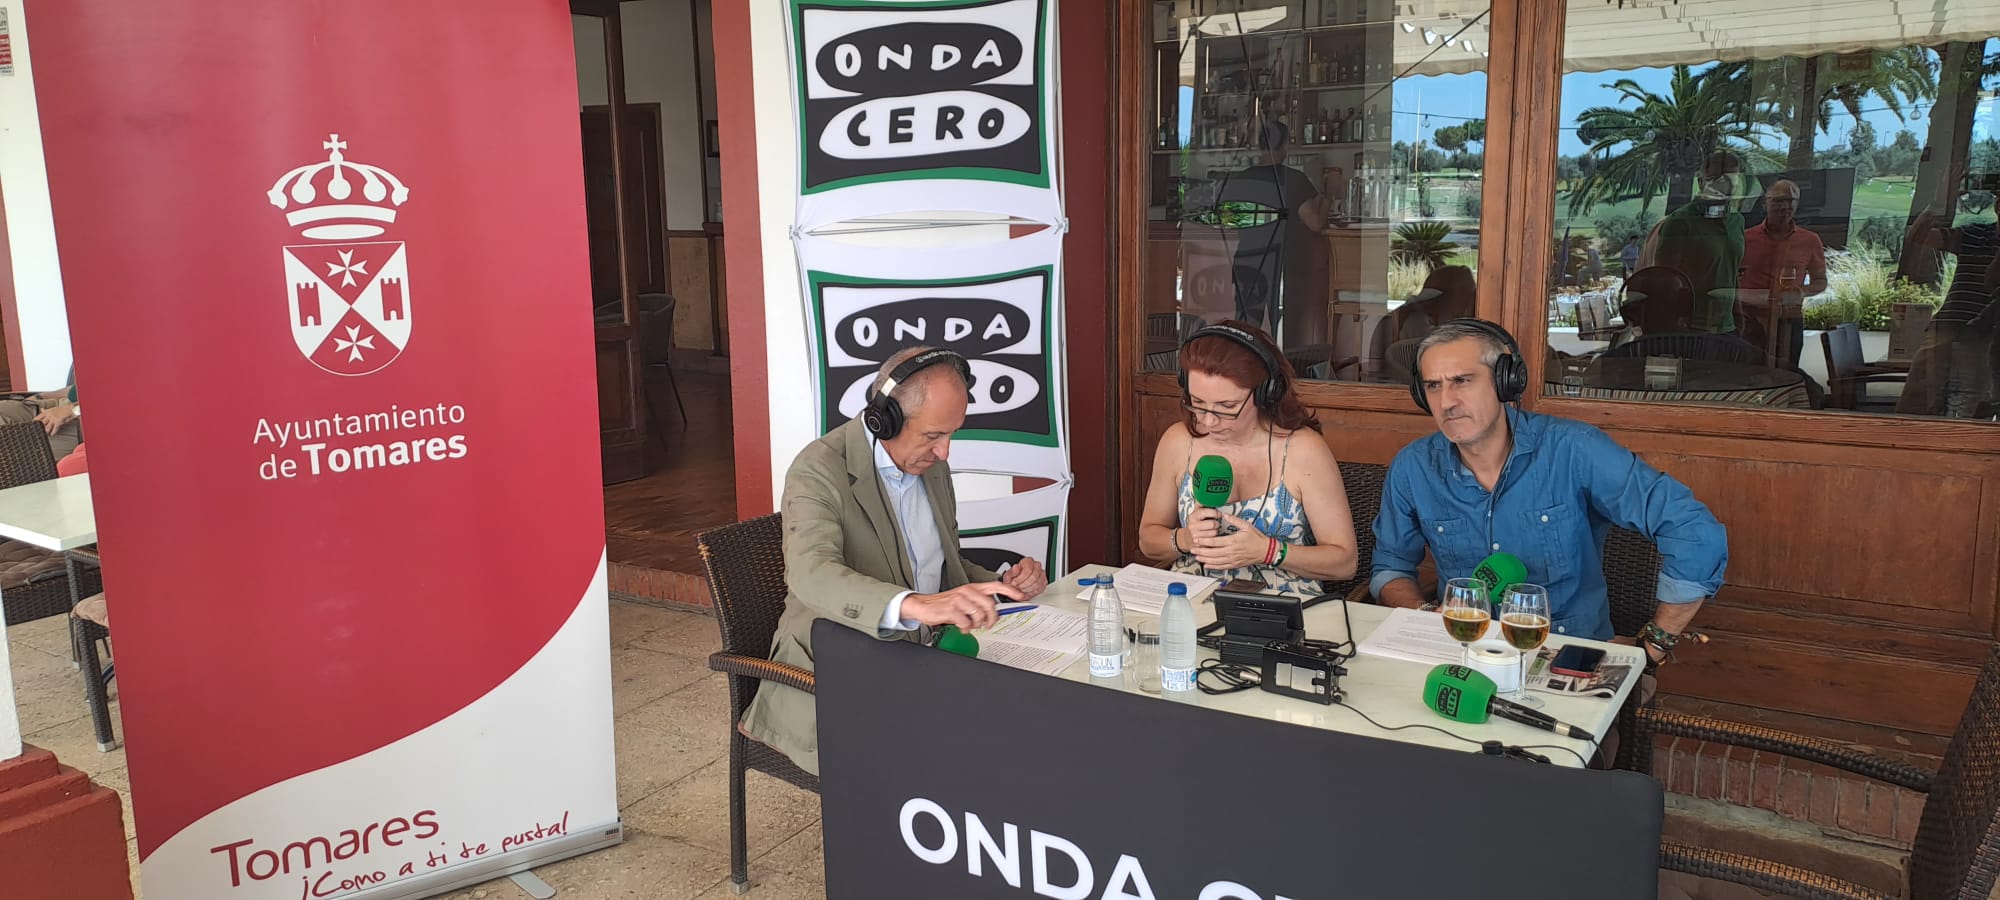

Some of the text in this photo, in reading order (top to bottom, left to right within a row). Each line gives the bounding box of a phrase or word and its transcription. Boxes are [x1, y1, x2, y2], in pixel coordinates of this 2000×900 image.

[834, 39, 1003, 77] ONDA
[846, 104, 1005, 147] CERO
[852, 312, 1012, 348] ONDA
[253, 402, 466, 449] Ayuntamiento
[258, 433, 468, 481] de Tomares
[210, 809, 440, 888] Tomares
[399, 861, 414, 877] a
[426, 841, 448, 868] ti
[459, 841, 489, 859] te
[899, 797, 1157, 900] ONDA
